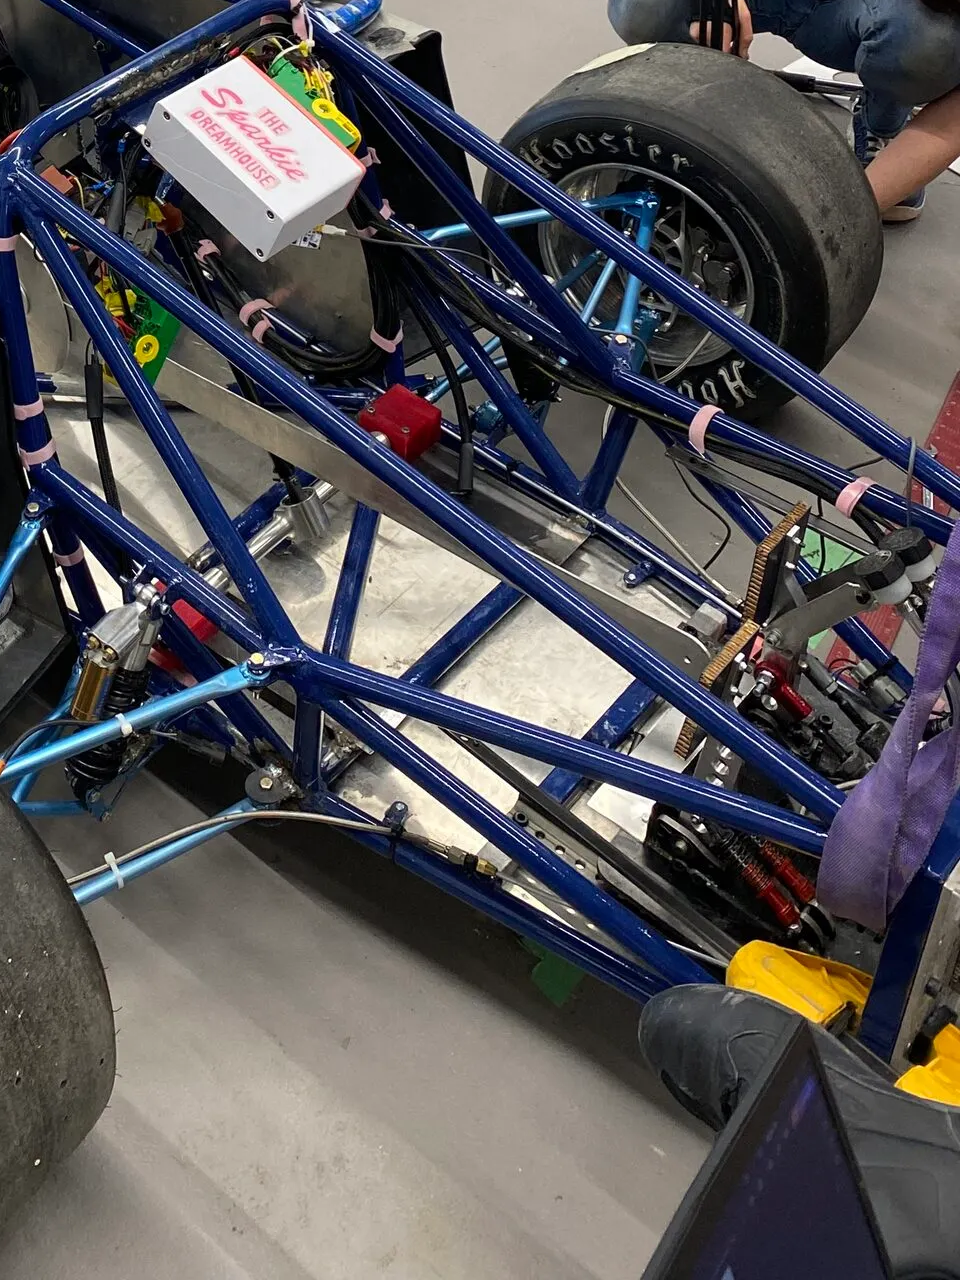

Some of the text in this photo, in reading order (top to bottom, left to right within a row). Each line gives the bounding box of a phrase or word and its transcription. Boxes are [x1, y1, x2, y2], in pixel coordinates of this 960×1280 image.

[190, 109, 277, 188] DREAMHOUSE
[200, 86, 306, 182] Sparkie
[259, 108, 289, 135] THE
[519, 124, 694, 178] Hoosier
